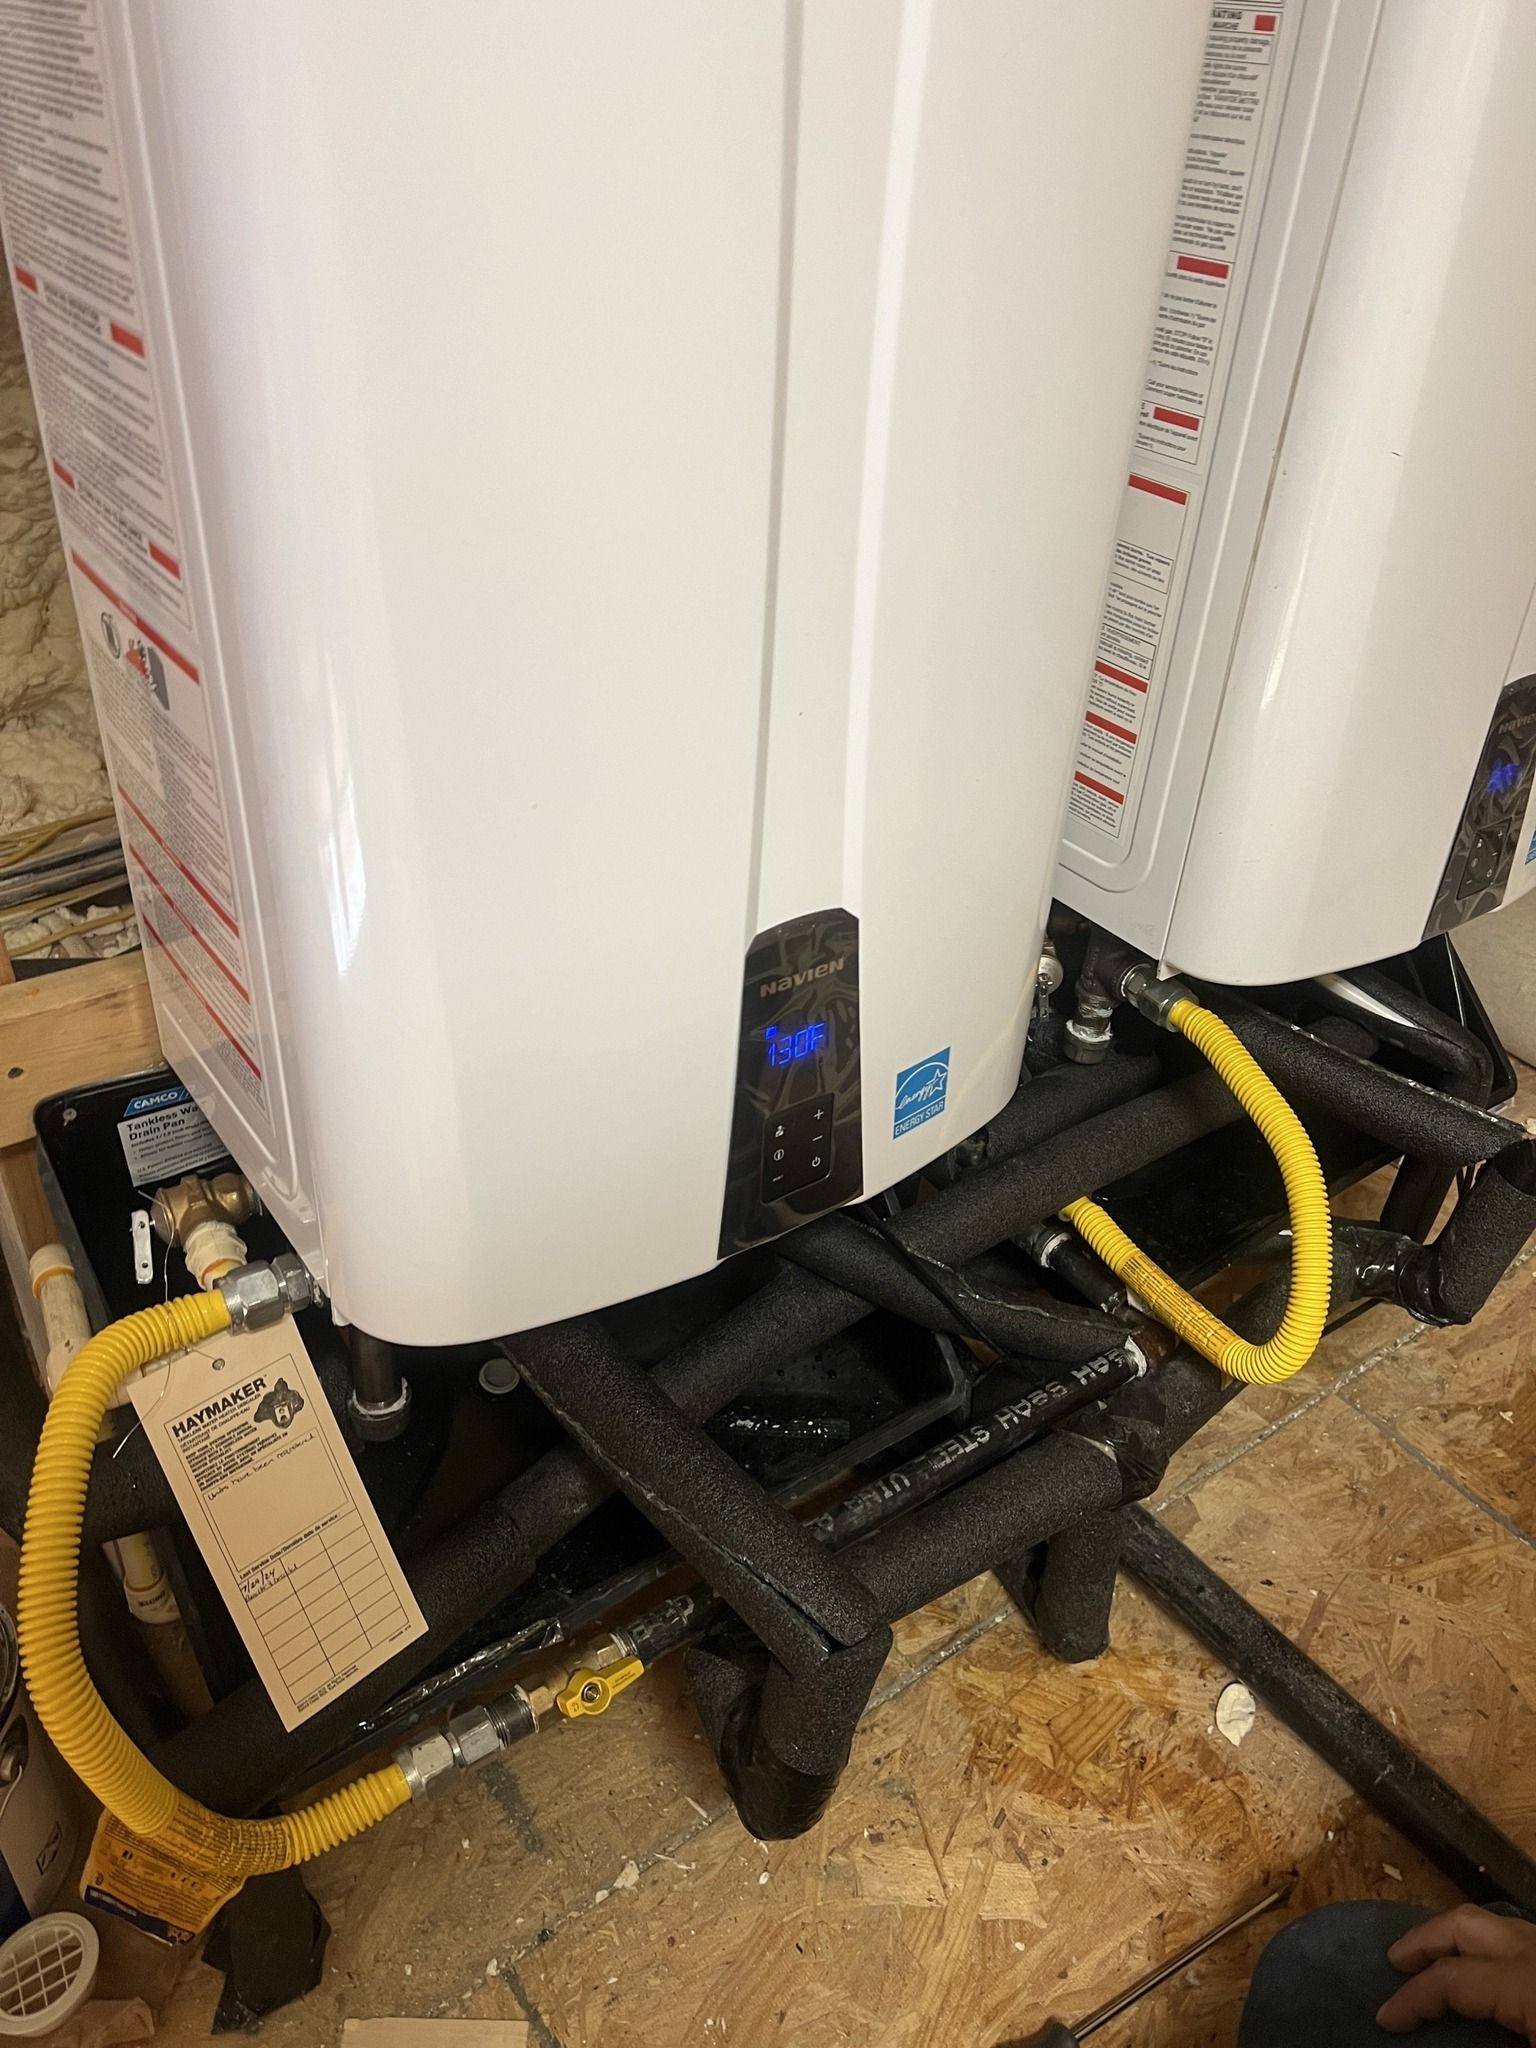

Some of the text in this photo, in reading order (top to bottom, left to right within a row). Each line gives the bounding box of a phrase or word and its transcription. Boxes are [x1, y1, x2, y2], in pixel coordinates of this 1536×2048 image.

[134, 1092, 178, 1110] CAMCO
[127, 1103, 198, 1131] Tankless Wa
[128, 1117, 185, 1140] Drain Pan
[895, 1100, 945, 1135] ENERGY STAR
[171, 1376, 266, 1437] HAYMAKER
[201, 1417, 218, 1429] WATER
[217, 1406, 237, 1419] HEATER
[230, 1468, 253, 1488] have
